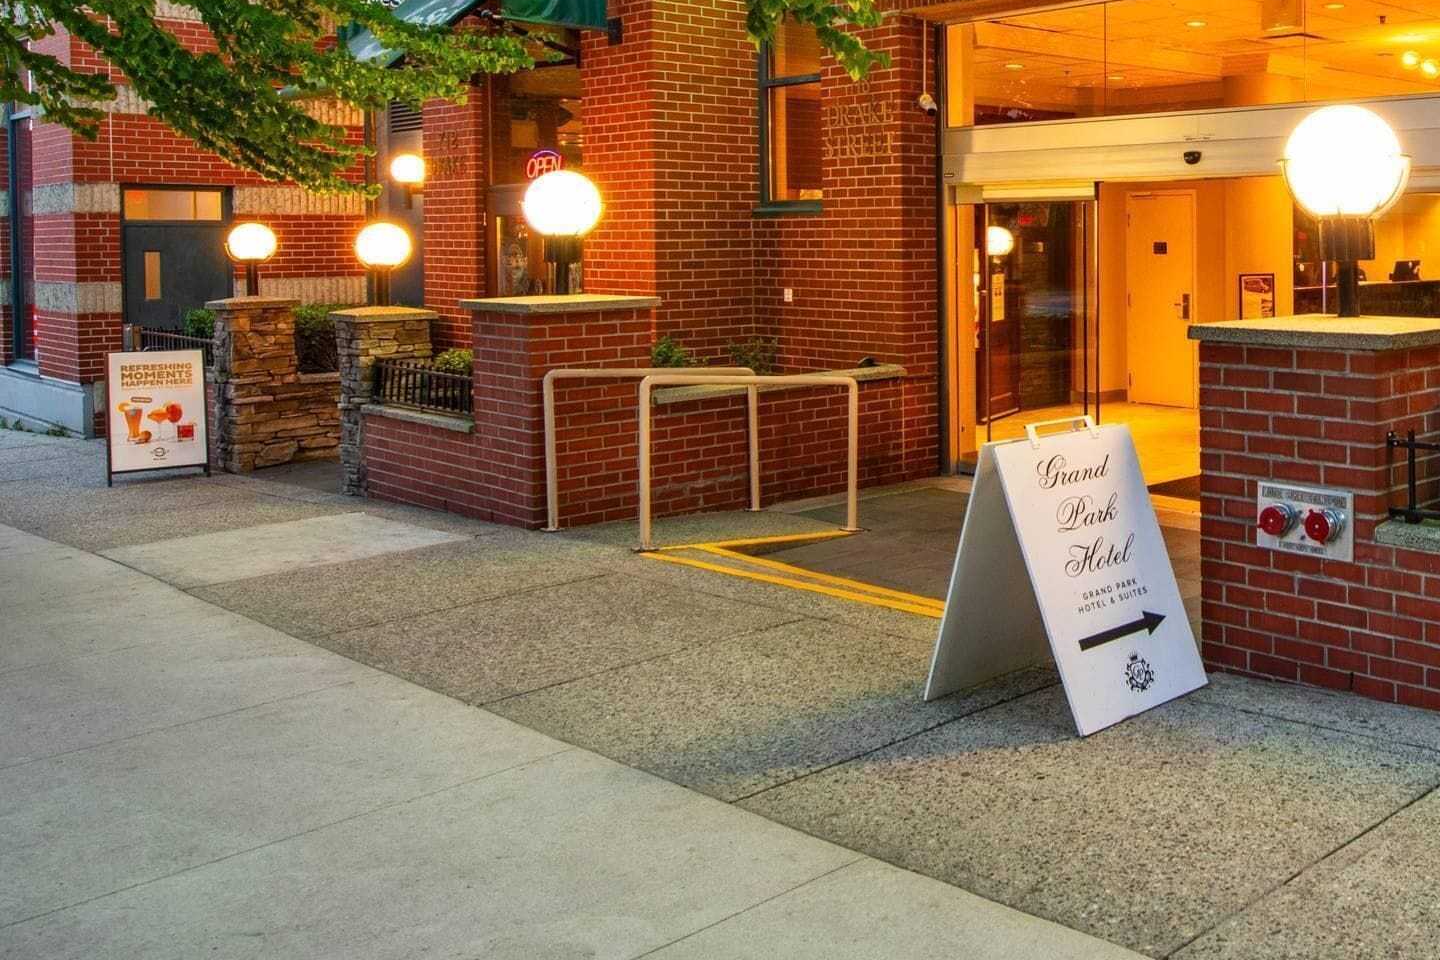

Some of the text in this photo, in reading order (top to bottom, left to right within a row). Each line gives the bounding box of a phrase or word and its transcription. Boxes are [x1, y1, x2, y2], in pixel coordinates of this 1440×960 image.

[827, 101, 895, 127] DRAKE
[825, 131, 896, 159] STREET
[527, 155, 562, 179] OPEN
[120, 363, 193, 372] REFRESHING
[121, 370, 193, 380] MOMENTS
[121, 379, 163, 387] HAPPEN
[1037, 453, 1109, 489] Grand
[1057, 492, 1118, 533] Park
[1065, 533, 1135, 578] Hotel
[1078, 586, 1148, 615] HOTEL & SUITES
[1082, 578, 1137, 601] GRAND PARK
